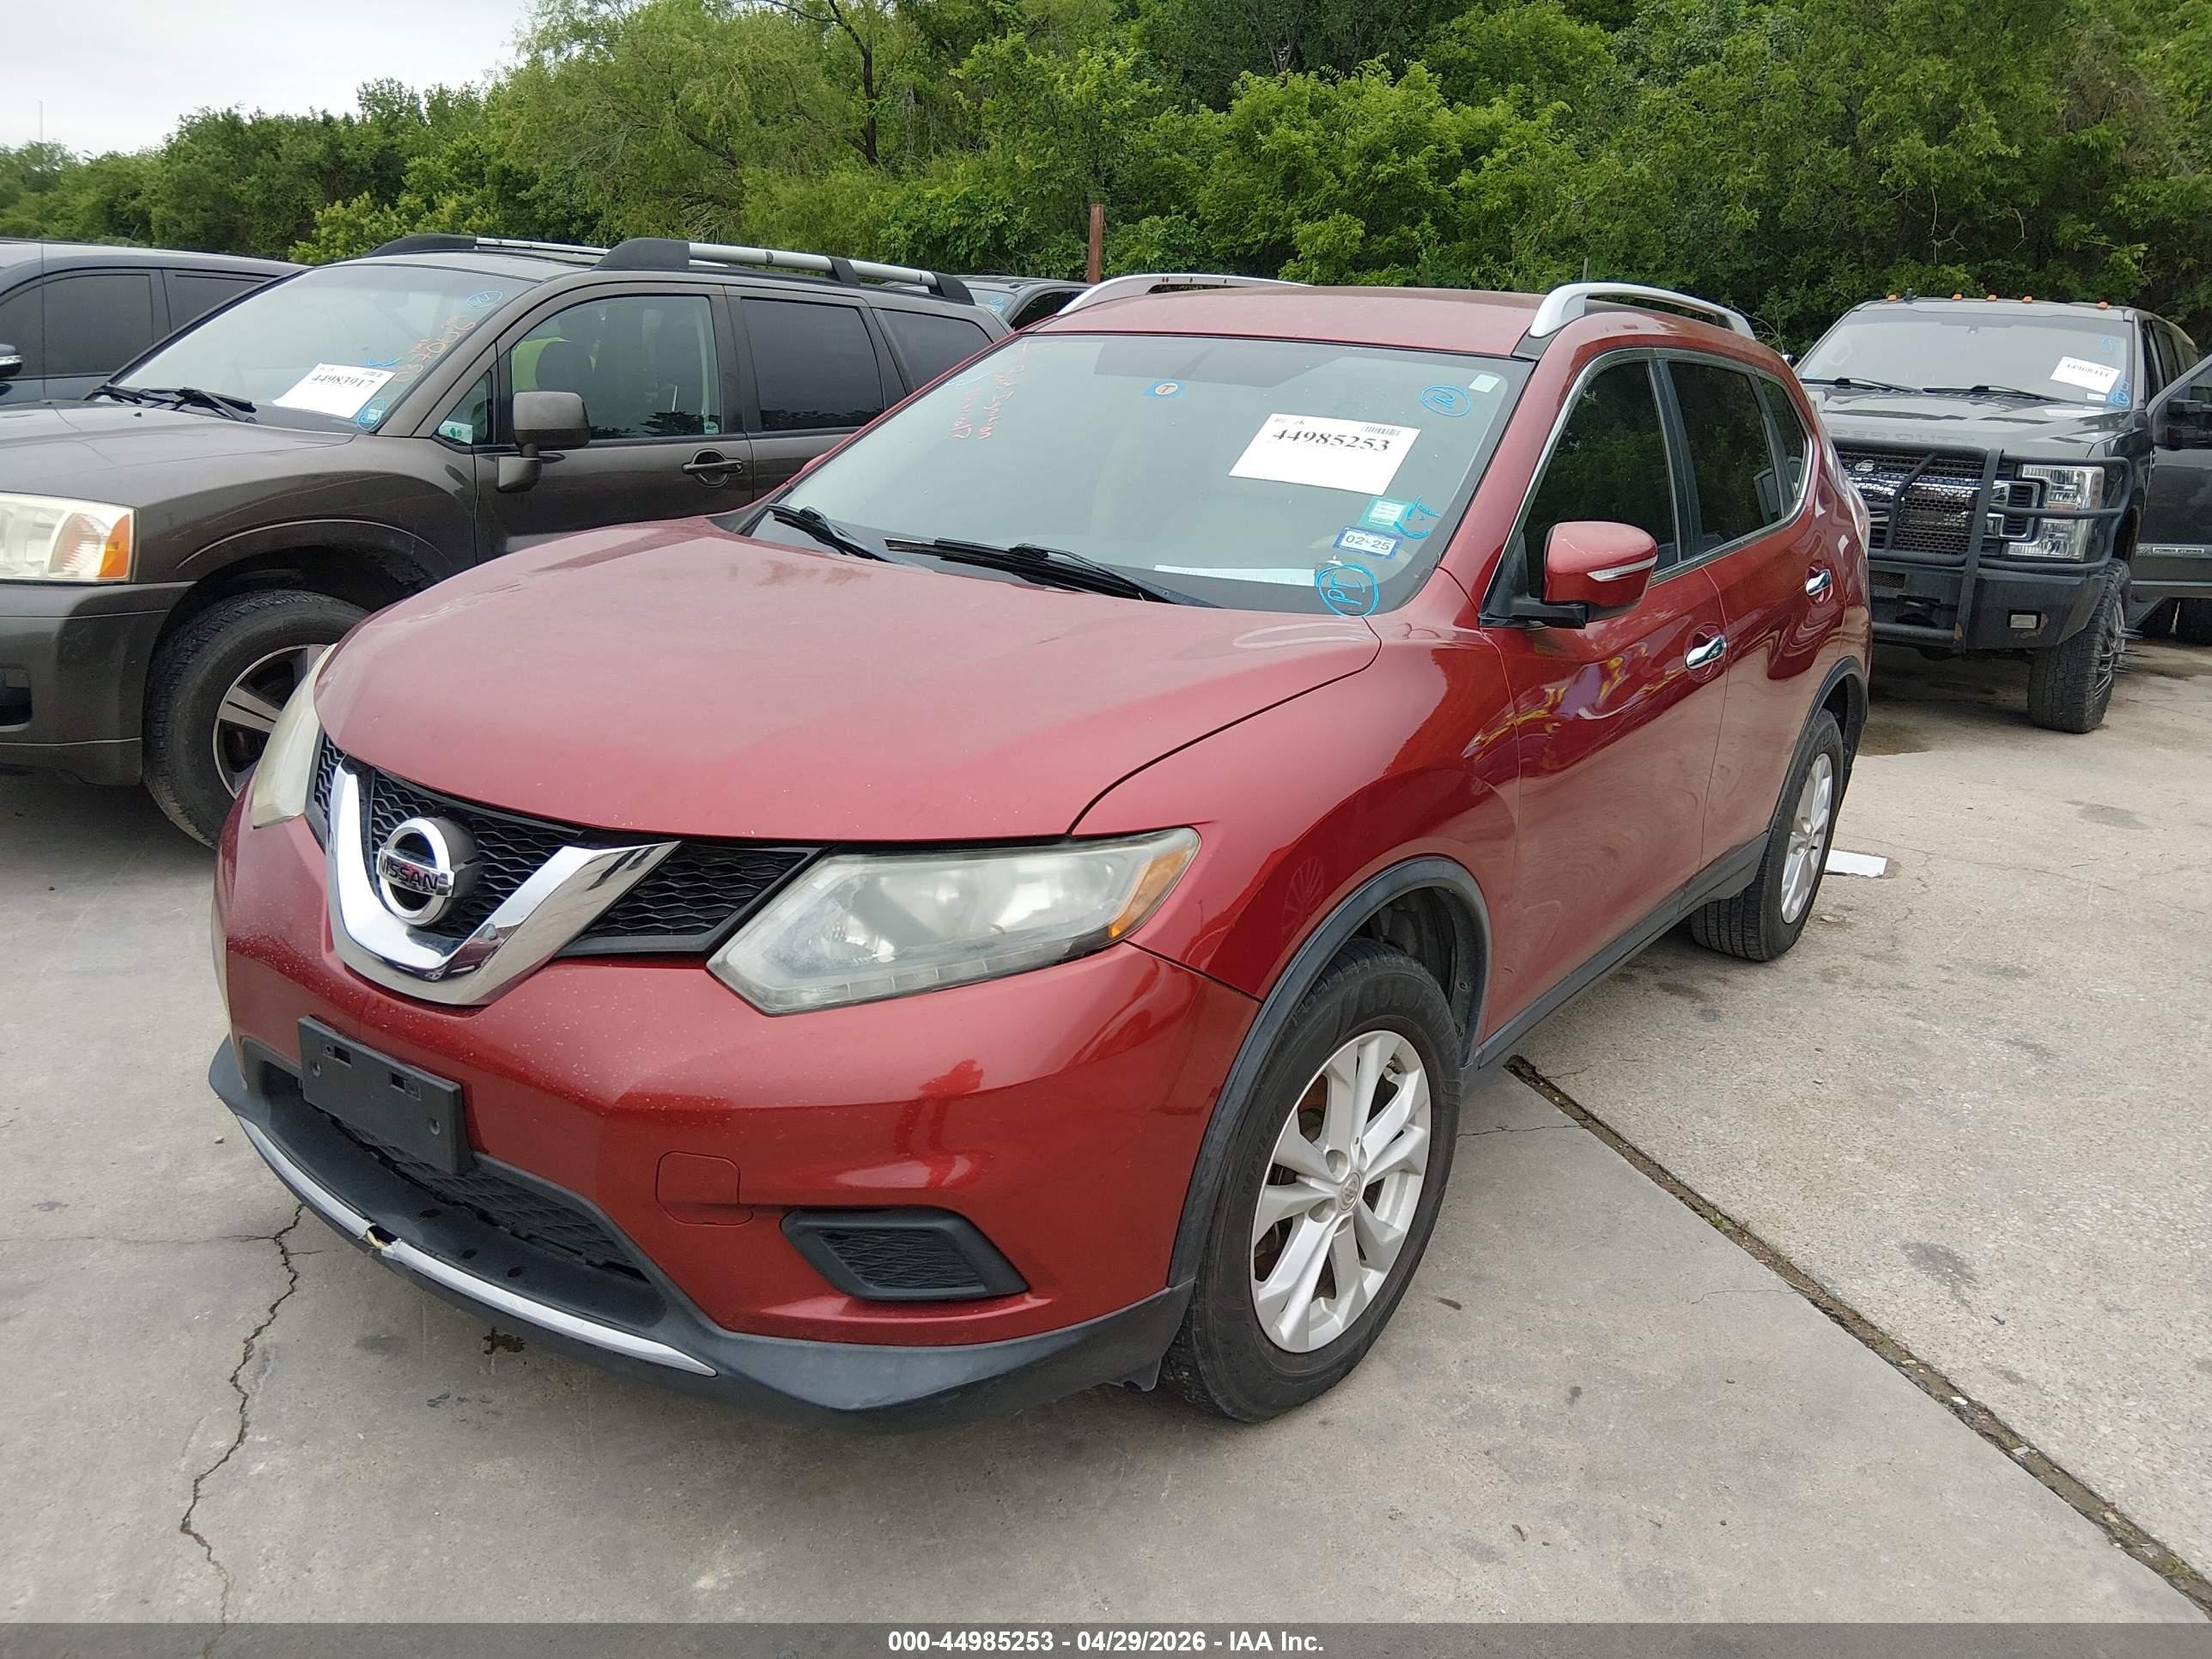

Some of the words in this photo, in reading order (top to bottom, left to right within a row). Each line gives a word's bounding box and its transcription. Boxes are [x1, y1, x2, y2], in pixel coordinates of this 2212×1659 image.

[312, 374, 375, 388] 44983917
[1272, 428, 1391, 453] 44985253
[379, 855, 439, 890] NISSAN
